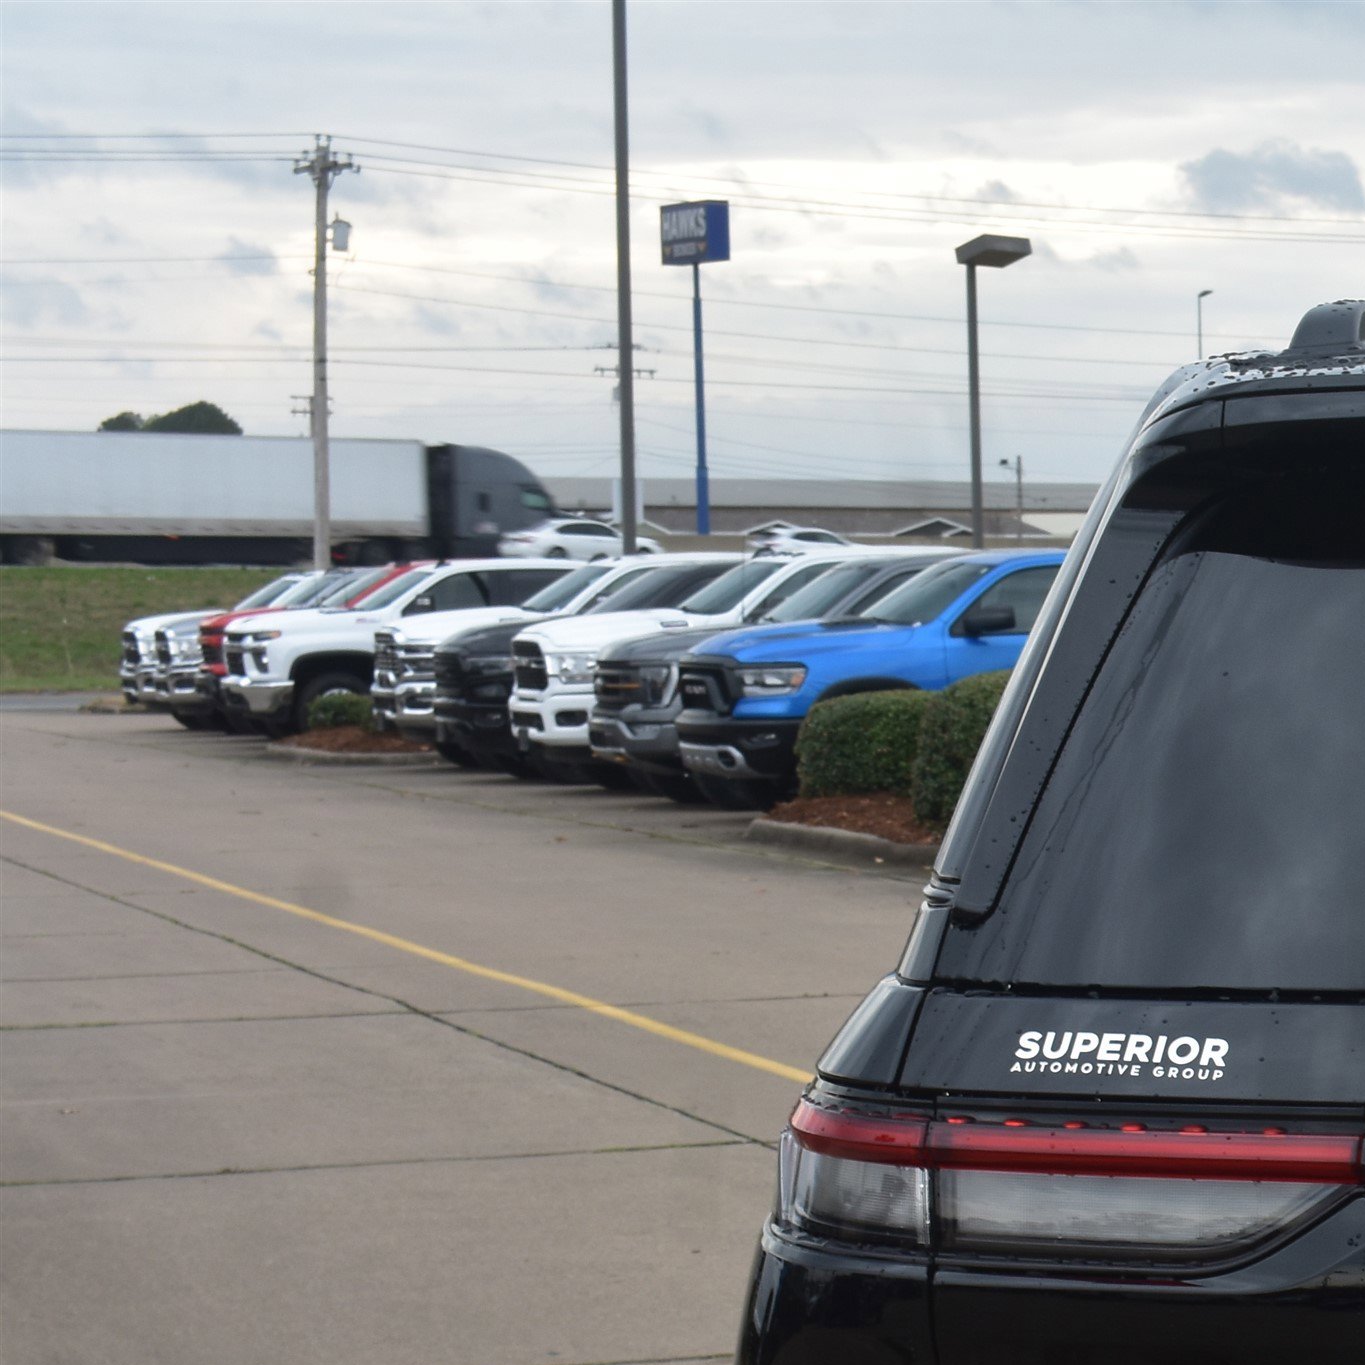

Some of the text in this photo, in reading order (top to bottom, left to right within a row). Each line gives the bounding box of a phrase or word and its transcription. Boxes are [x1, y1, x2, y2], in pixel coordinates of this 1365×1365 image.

[1015, 1031, 1229, 1067] SUPERIOR
[1010, 1061, 1224, 1081] AUTOMOTIVE GROUP
